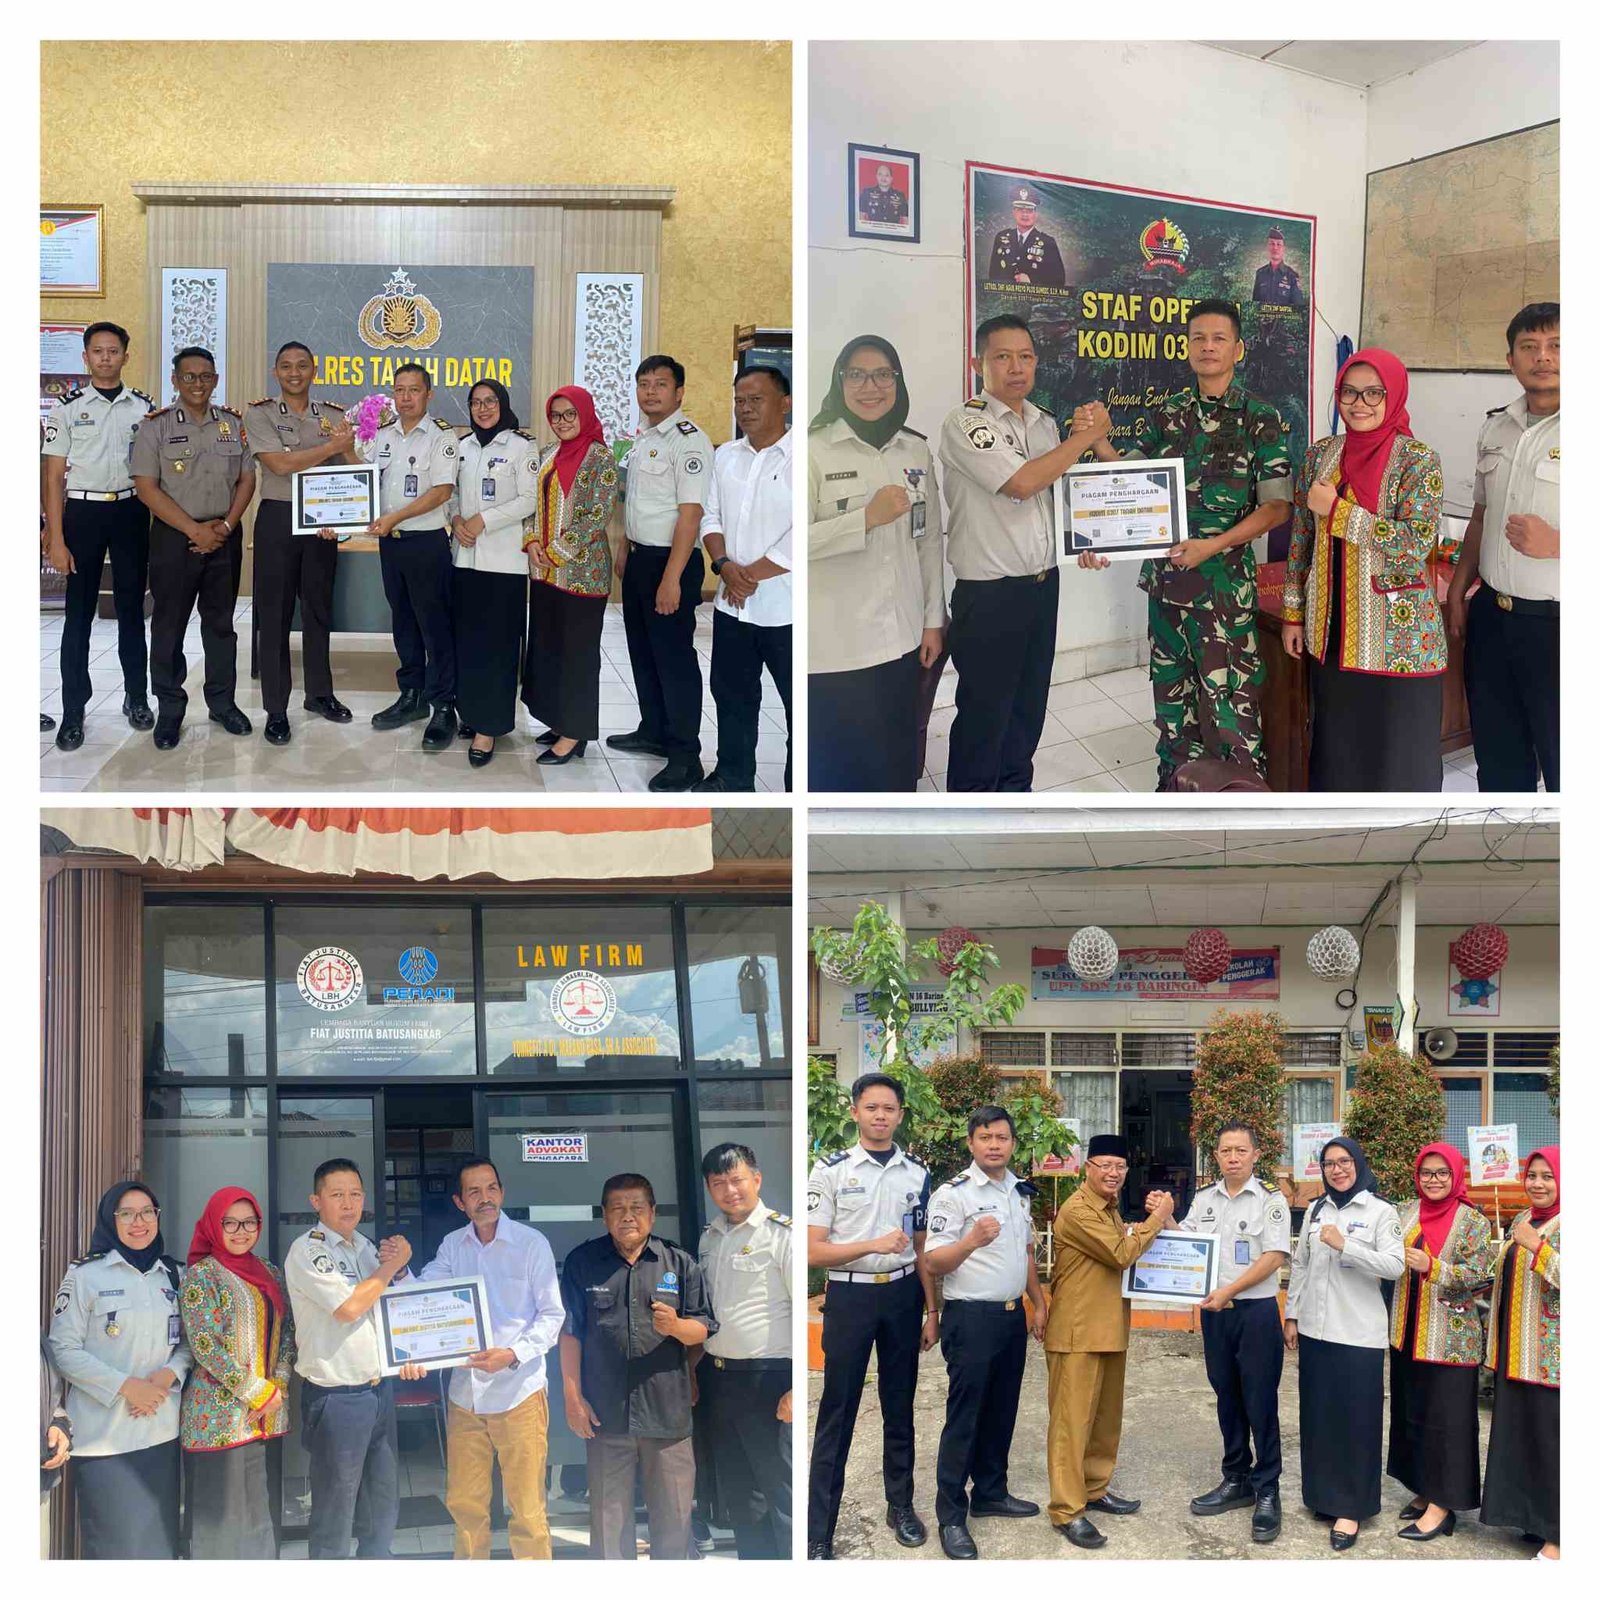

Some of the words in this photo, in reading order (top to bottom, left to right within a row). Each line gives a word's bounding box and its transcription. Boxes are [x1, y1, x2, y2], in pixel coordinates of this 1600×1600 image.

[1082, 291, 1143, 321] STAF
[1077, 330, 1157, 359] KODIM
[312, 355, 364, 386] LRES
[445, 356, 513, 388] DATAR
[1081, 491, 1108, 499] PIAGAM
[1109, 488, 1159, 497] PENGHARGAAN
[298, 954, 313, 976] FIAT
[316, 948, 358, 970] JUSTITIA
[517, 945, 568, 968] LAW
[579, 944, 643, 967] FIRM
[1228, 959, 1254, 970] KOLAH
[1222, 966, 1266, 981] PENGGERAK
[383, 987, 455, 1001] PERADI
[1081, 981, 1110, 993] SDN
[1115, 981, 1132, 992] 16
[301, 982, 362, 1010] BATUSANGKAR
[321, 992, 340, 1000] LBH
[310, 1028, 330, 1039] FIAT
[333, 1028, 374, 1039] JUSTITIA
[376, 1028, 442, 1040] BATUSANGKAR
[527, 1138, 582, 1146] KANTOR
